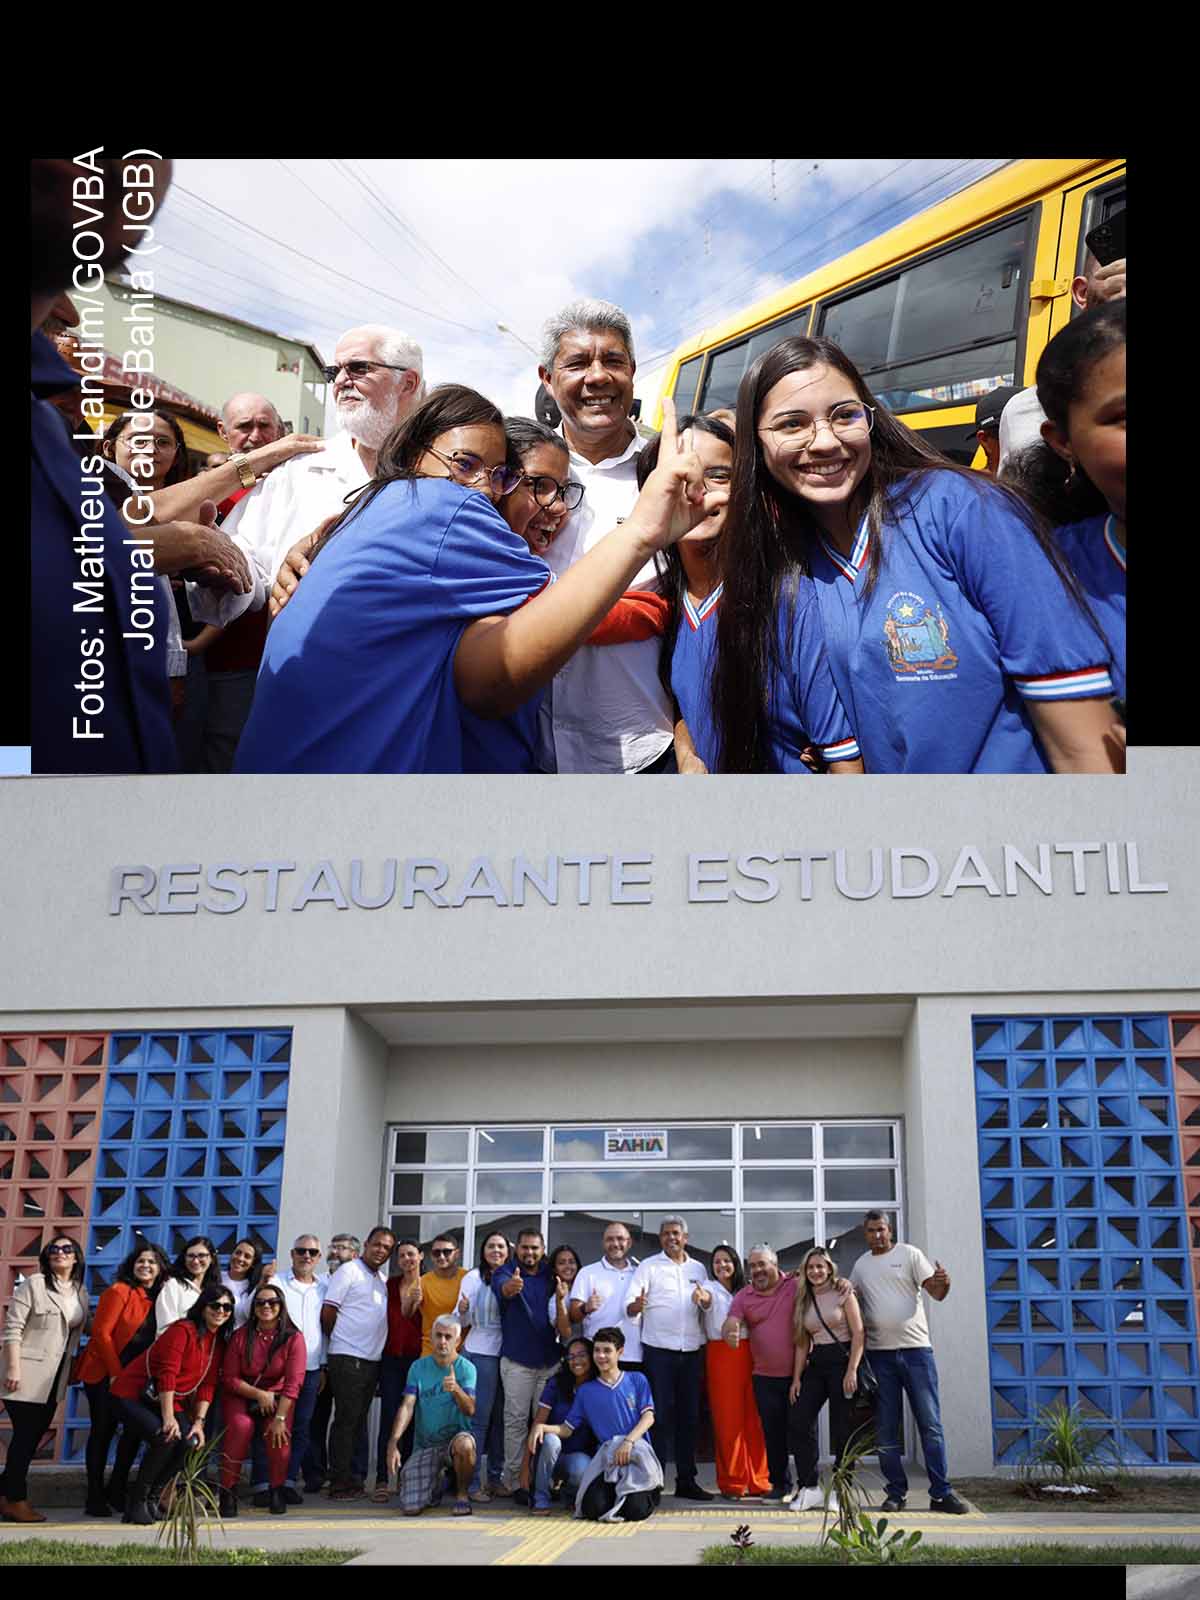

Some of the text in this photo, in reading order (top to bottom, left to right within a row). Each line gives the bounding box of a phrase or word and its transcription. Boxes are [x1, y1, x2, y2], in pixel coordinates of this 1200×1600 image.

[109, 841, 1169, 915] RESTAURANTE ESTUDANTIL
[608, 1138, 664, 1152] BAHIA
